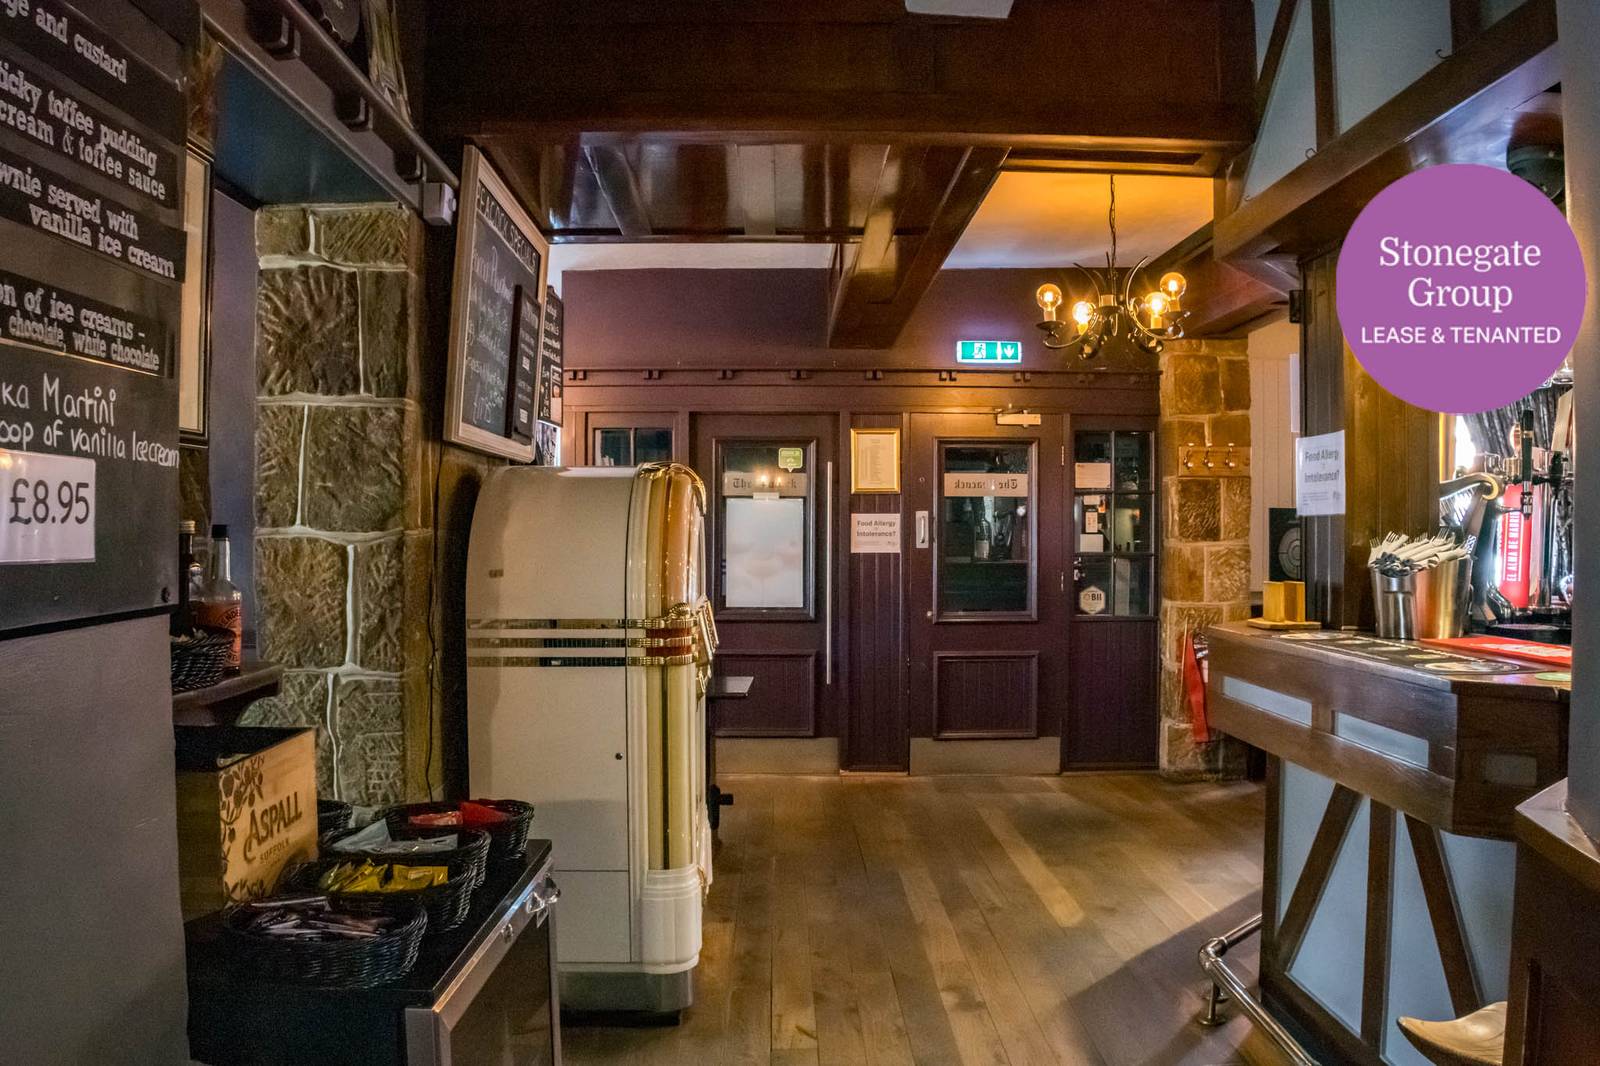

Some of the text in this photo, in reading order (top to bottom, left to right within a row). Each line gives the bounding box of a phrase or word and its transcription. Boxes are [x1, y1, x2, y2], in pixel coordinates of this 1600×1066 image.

[36, 8, 68, 44] and
[74, 33, 127, 84] custard
[48, 89, 94, 136] toffee
[100, 124, 157, 177] pudding
[63, 126, 74, 155] &
[79, 136, 123, 179] toffee
[129, 167, 166, 200] sauce
[29, 203, 176, 279] vanilla ice cream
[48, 184, 101, 224] served
[106, 209, 139, 241] with
[24, 288, 44, 315] of
[50, 293, 74, 324] ice
[80, 308, 133, 340] creams
[72, 329, 107, 358] white
[111, 338, 160, 371] chocolate
[43, 372, 117, 427] Martini
[43, 419, 64, 448] of
[70, 427, 126, 459] vanilla
[9, 478, 89, 525] £8.95
[243, 791, 303, 864] ASPALL
